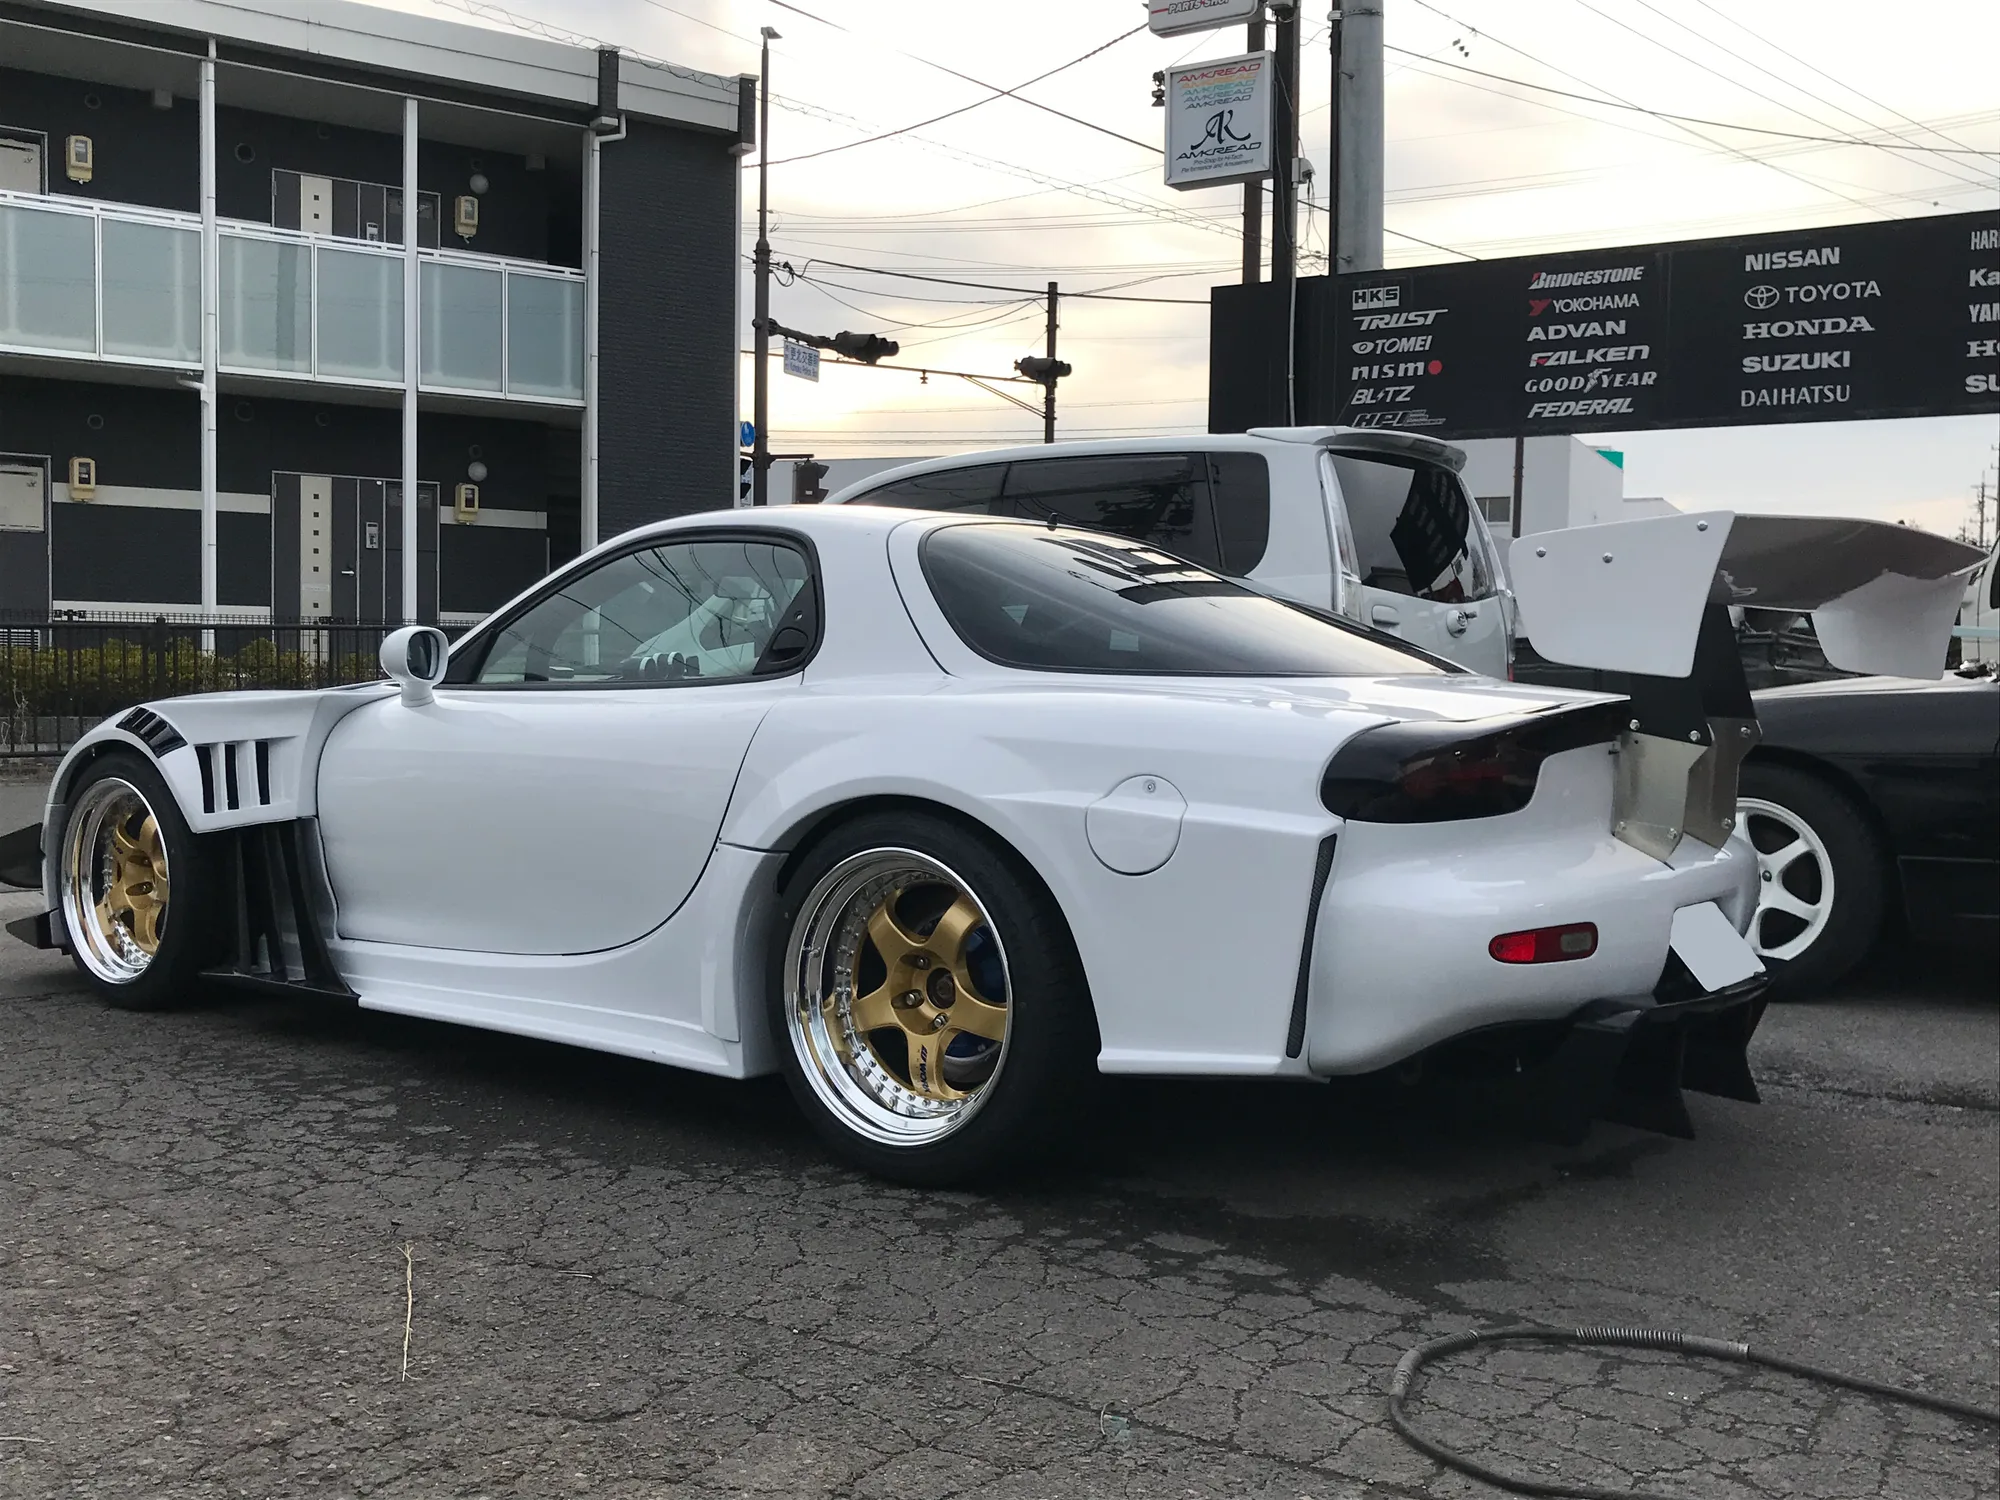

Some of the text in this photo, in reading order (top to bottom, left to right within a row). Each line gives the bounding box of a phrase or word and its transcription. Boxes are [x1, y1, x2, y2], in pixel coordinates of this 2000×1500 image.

[1168, 0, 1201, 14] PARTS
[1177, 63, 1261, 83] AMKREAD
[1181, 79, 1256, 96] AMKREAD
[1184, 87, 1254, 103] AMKREAD
[1185, 94, 1252, 110] AMKREAD
[1176, 142, 1262, 161] AMKREAD
[1970, 229, 2000, 251] HAR
[1744, 247, 1840, 272] NISSAN
[1528, 266, 1645, 290] BRIDGESTONE
[1352, 286, 1399, 308] HKS
[1784, 280, 1882, 304] TOYOTA
[1552, 293, 1640, 314] YOKOHAMA
[1353, 309, 1449, 331] TRUST
[1527, 320, 1627, 342] ADVAN
[1742, 315, 1875, 340] HONDA
[1374, 335, 1433, 355] TOMEI
[1529, 345, 1650, 367] FALKEN
[1966, 339, 2000, 358] H
[1742, 350, 1850, 374] SUZUKI
[1351, 386, 1415, 405] BLITZ
[1740, 384, 1850, 408] DAIHATSU
[1527, 397, 1635, 419] FEDERAL
[919, 1063, 932, 1093] WORK
